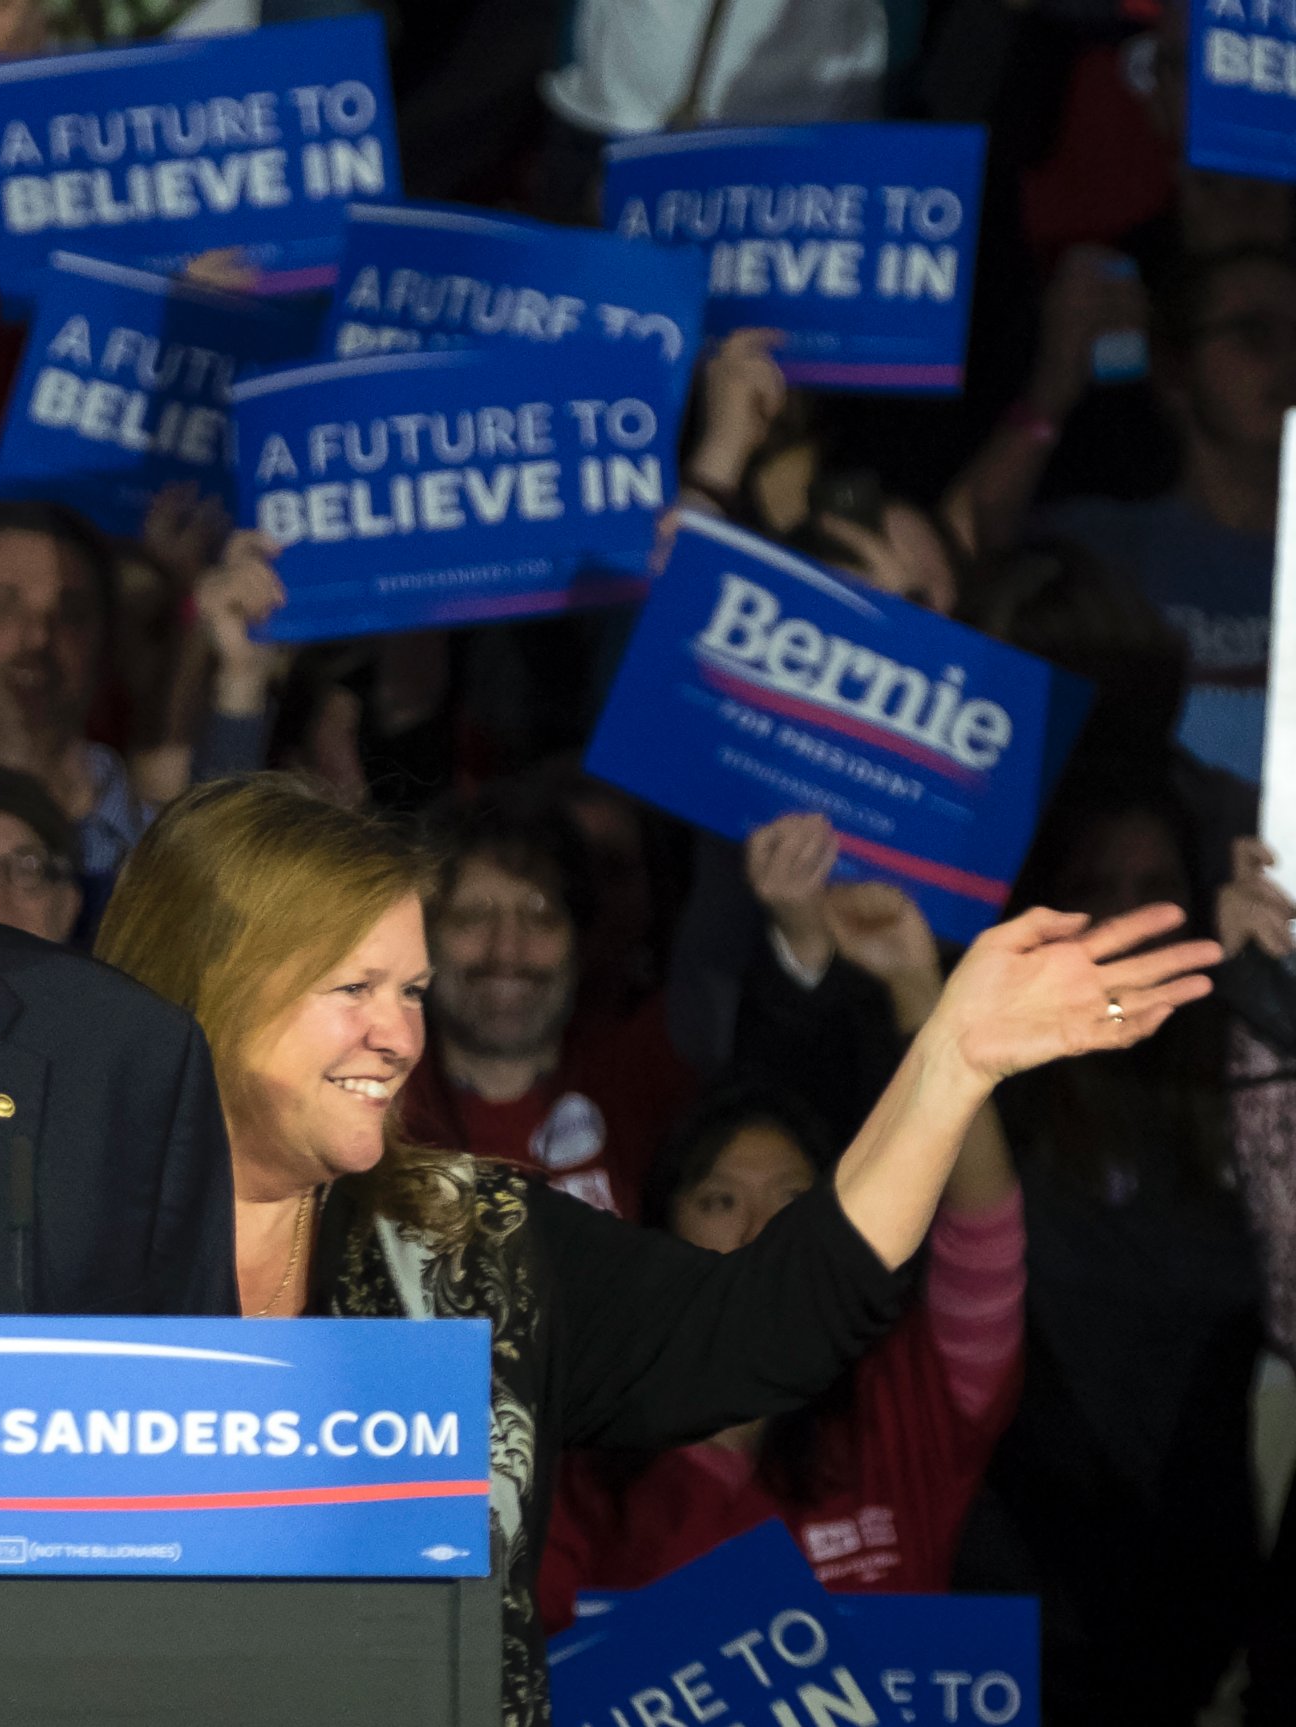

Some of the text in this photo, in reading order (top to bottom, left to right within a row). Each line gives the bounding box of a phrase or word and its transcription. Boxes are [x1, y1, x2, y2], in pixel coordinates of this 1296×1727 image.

[0, 80, 377, 169] A FUTURE TO
[3, 135, 385, 236] BELIEVE IN
[655, 184, 868, 241] FUTURE
[880, 185, 963, 242] TO
[346, 265, 381, 312] A
[708, 239, 958, 302] IEVE IN
[46, 313, 92, 368] A
[28, 364, 240, 466] BELIE
[256, 398, 658, 485] A FUTURE TO
[256, 453, 664, 546] BELIEVE IN
[696, 572, 1013, 771] Bernie
[720, 1608, 829, 1689] TO
[933, 1671, 1022, 1725] TO
